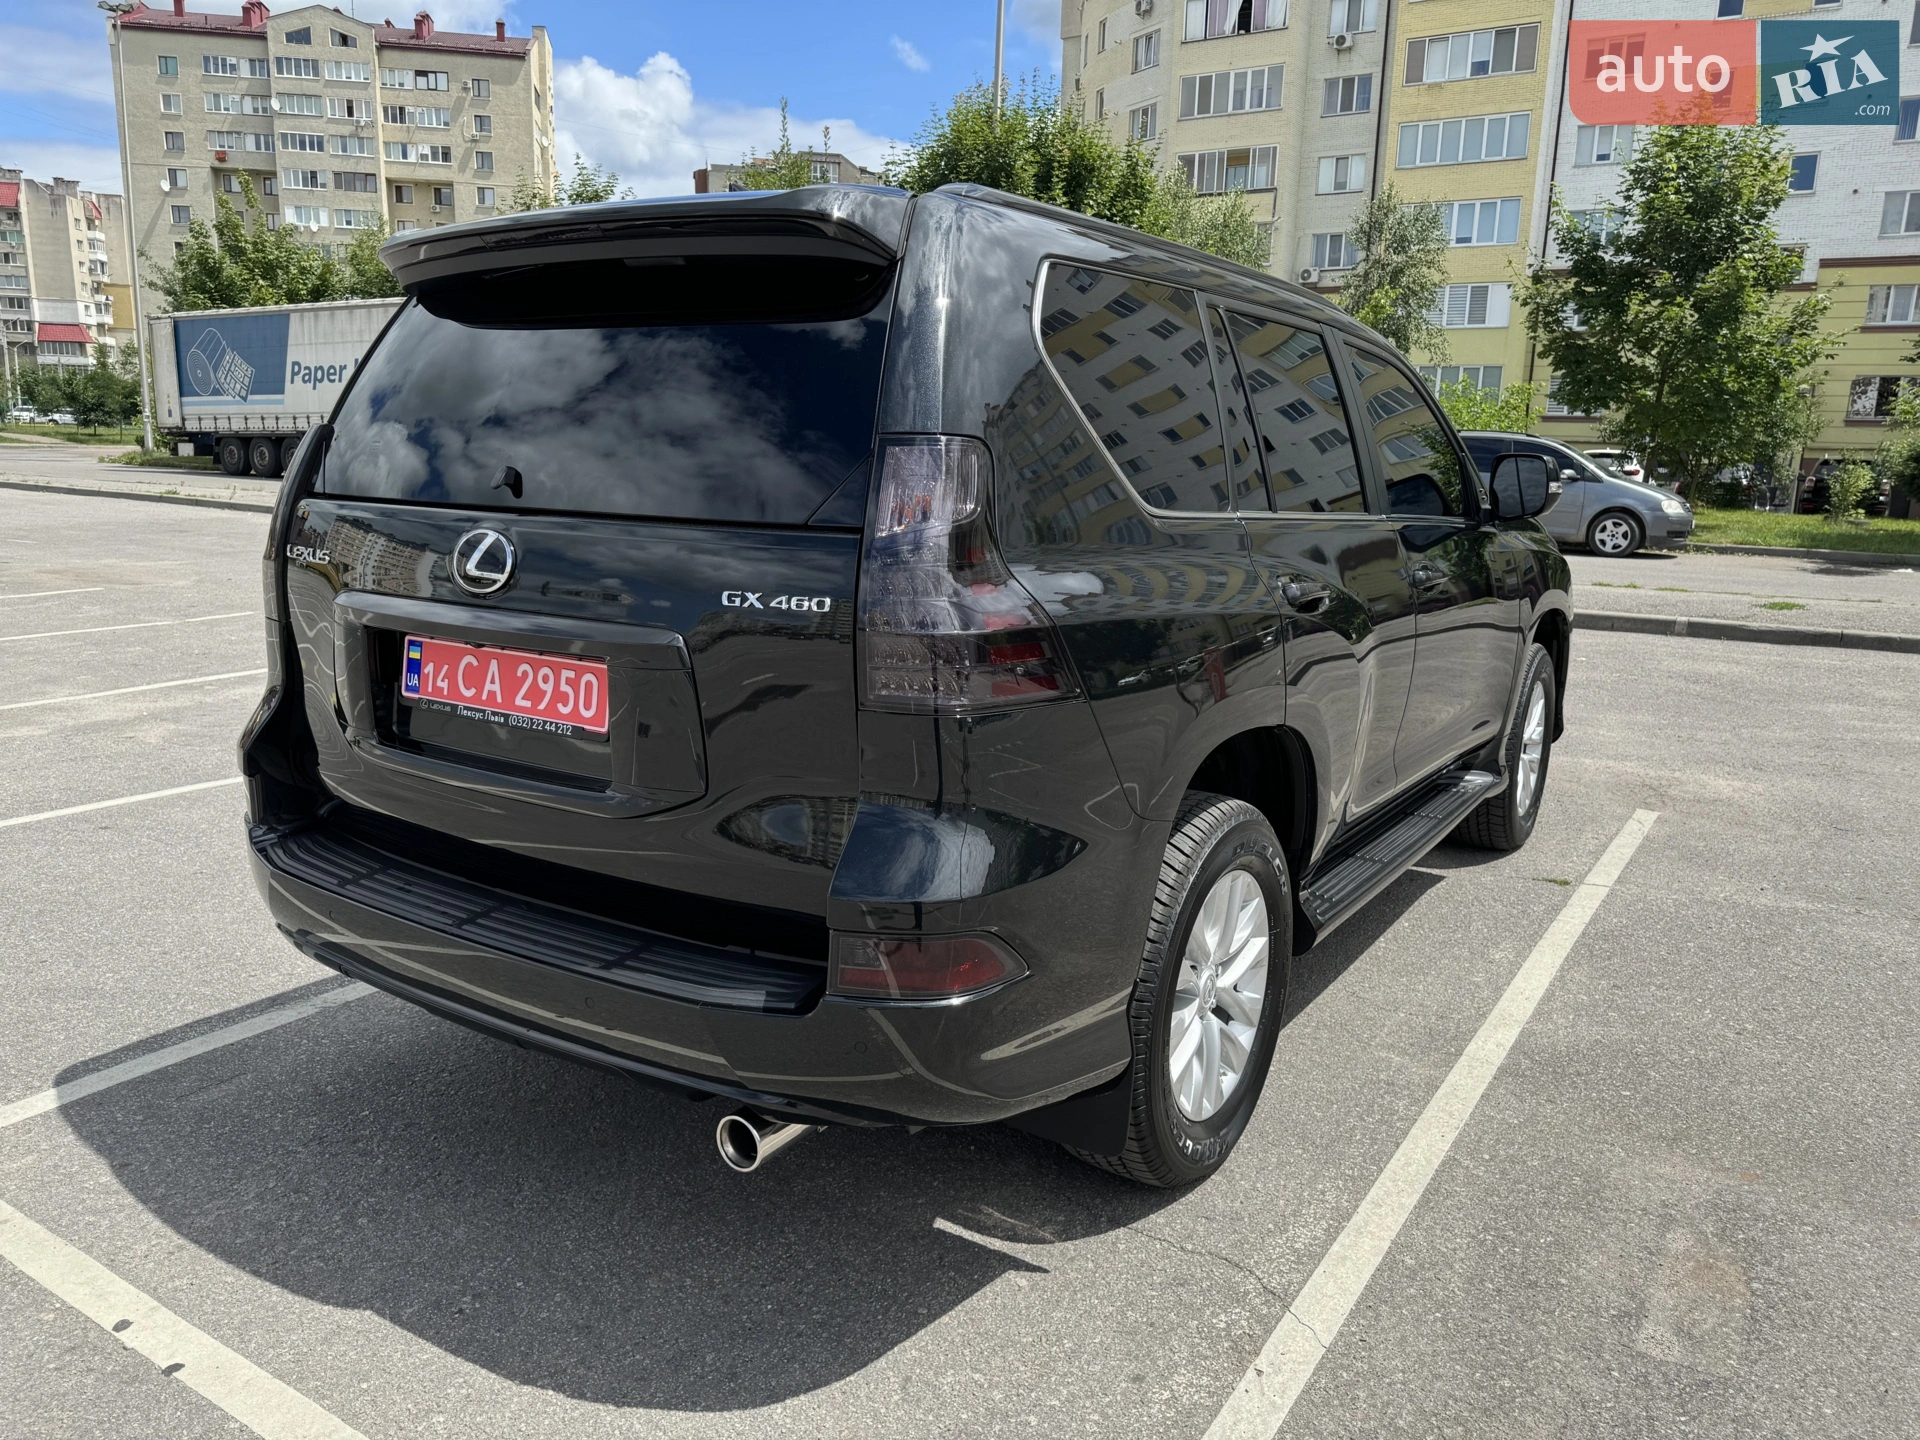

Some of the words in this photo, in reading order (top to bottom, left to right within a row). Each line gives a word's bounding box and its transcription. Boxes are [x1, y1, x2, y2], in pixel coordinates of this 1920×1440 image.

[290, 360, 347, 390] Paper
[286, 543, 331, 565] LEXUS
[721, 590, 764, 609] GX
[769, 595, 831, 613] 460
[407, 673, 420, 687] UA
[423, 661, 450, 696] 14
[457, 654, 503, 703] CA
[514, 662, 599, 718] 2950
[429, 702, 452, 712] LEXUS
[457, 705, 484, 719] Лексус
[484, 710, 505, 723] Львів
[508, 715, 531, 729] (032)
[532, 719, 543, 730] 22
[544, 722, 556, 732] 44
[557, 725, 572, 736] 212
